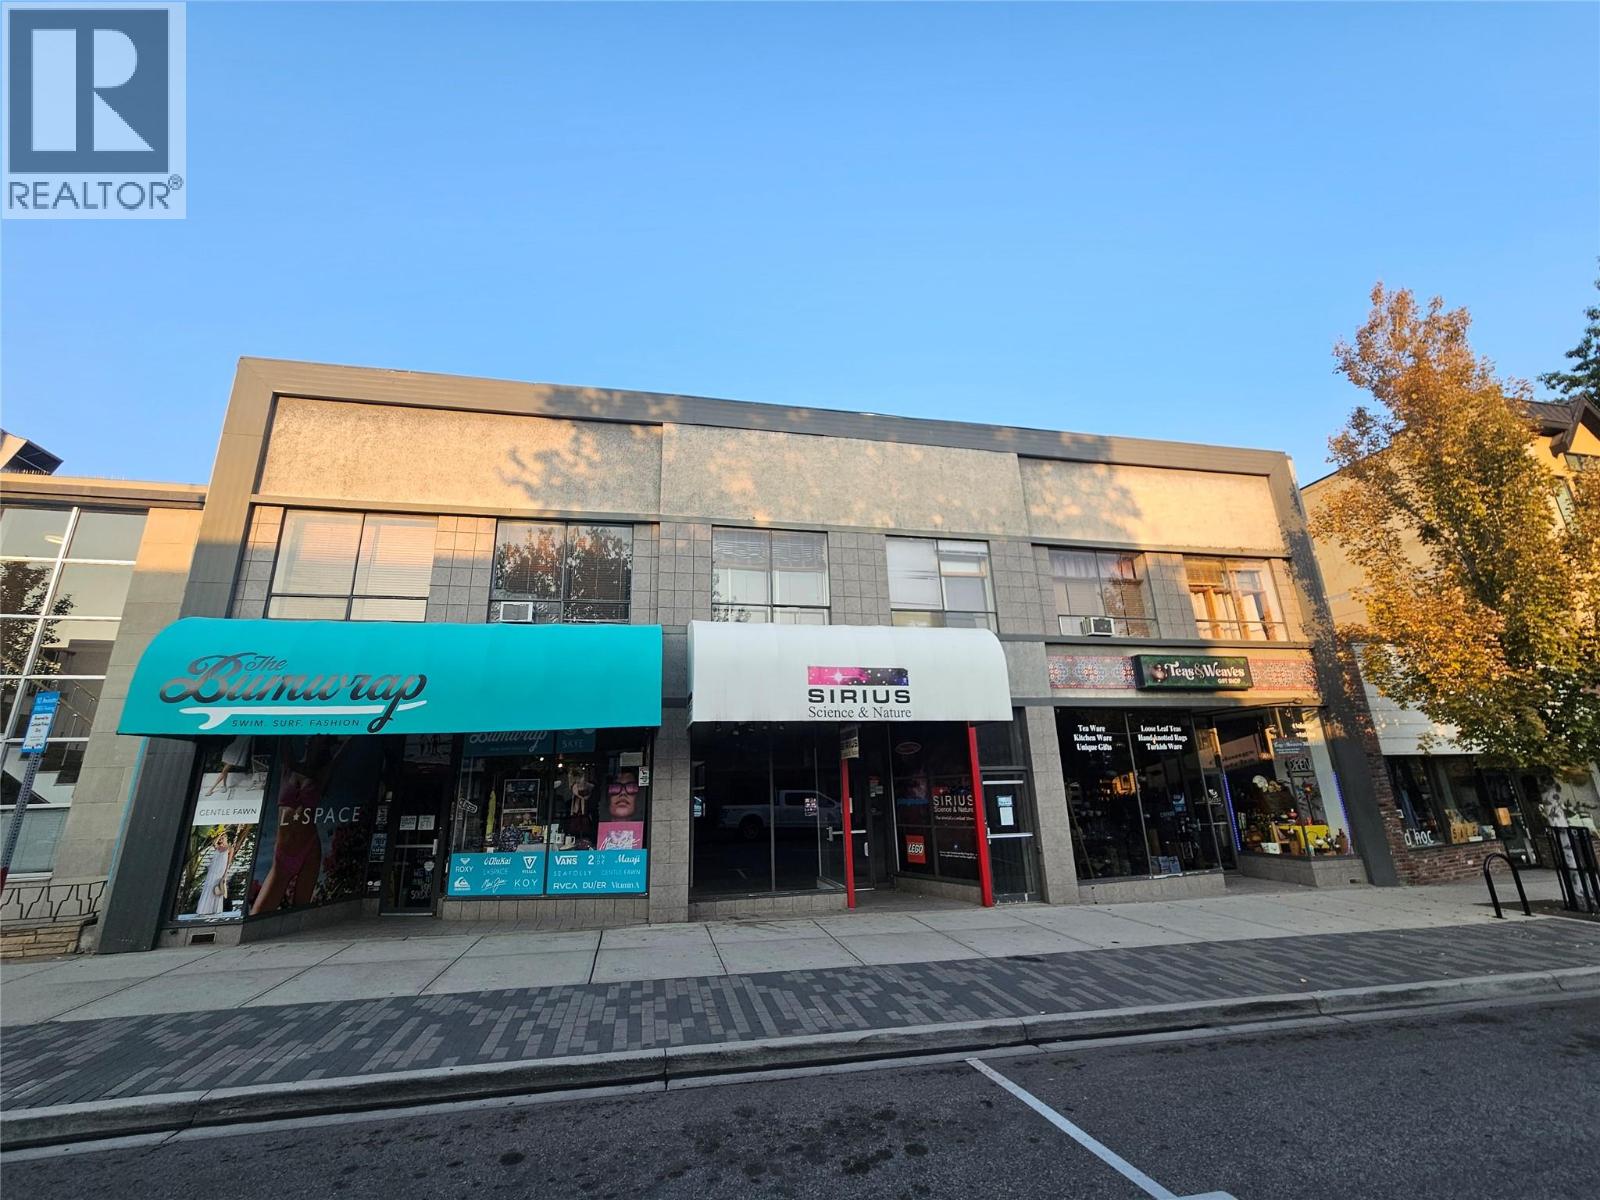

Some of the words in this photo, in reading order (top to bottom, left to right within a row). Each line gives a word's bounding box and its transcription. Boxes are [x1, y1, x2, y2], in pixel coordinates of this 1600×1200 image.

[245, 655, 287, 671] The
[159, 652, 427, 733] Bumwrap
[808, 689, 911, 703] SIRIUS
[808, 706, 854, 718] Science
[858, 706, 869, 718] &
[872, 706, 912, 718] Nature
[309, 718, 360, 727] FASHION
[1077, 724, 1089, 732] Tea
[1090, 724, 1106, 732] Ware
[1140, 724, 1156, 732] Loose
[1157, 724, 1169, 732] Leaf
[1169, 724, 1181, 732] Teas
[1076, 743, 1098, 752] Unique
[1098, 743, 1113, 751] Gifts
[933, 795, 974, 806] SIRIUS
[200, 809, 231, 817] GENTLE
[232, 808, 257, 816] FAWN
[907, 844, 925, 855] LEGO
[554, 855, 578, 865] VANS
[587, 855, 595, 865] 2
[514, 879, 538, 888] KOY
[582, 880, 607, 889] DU/ER
